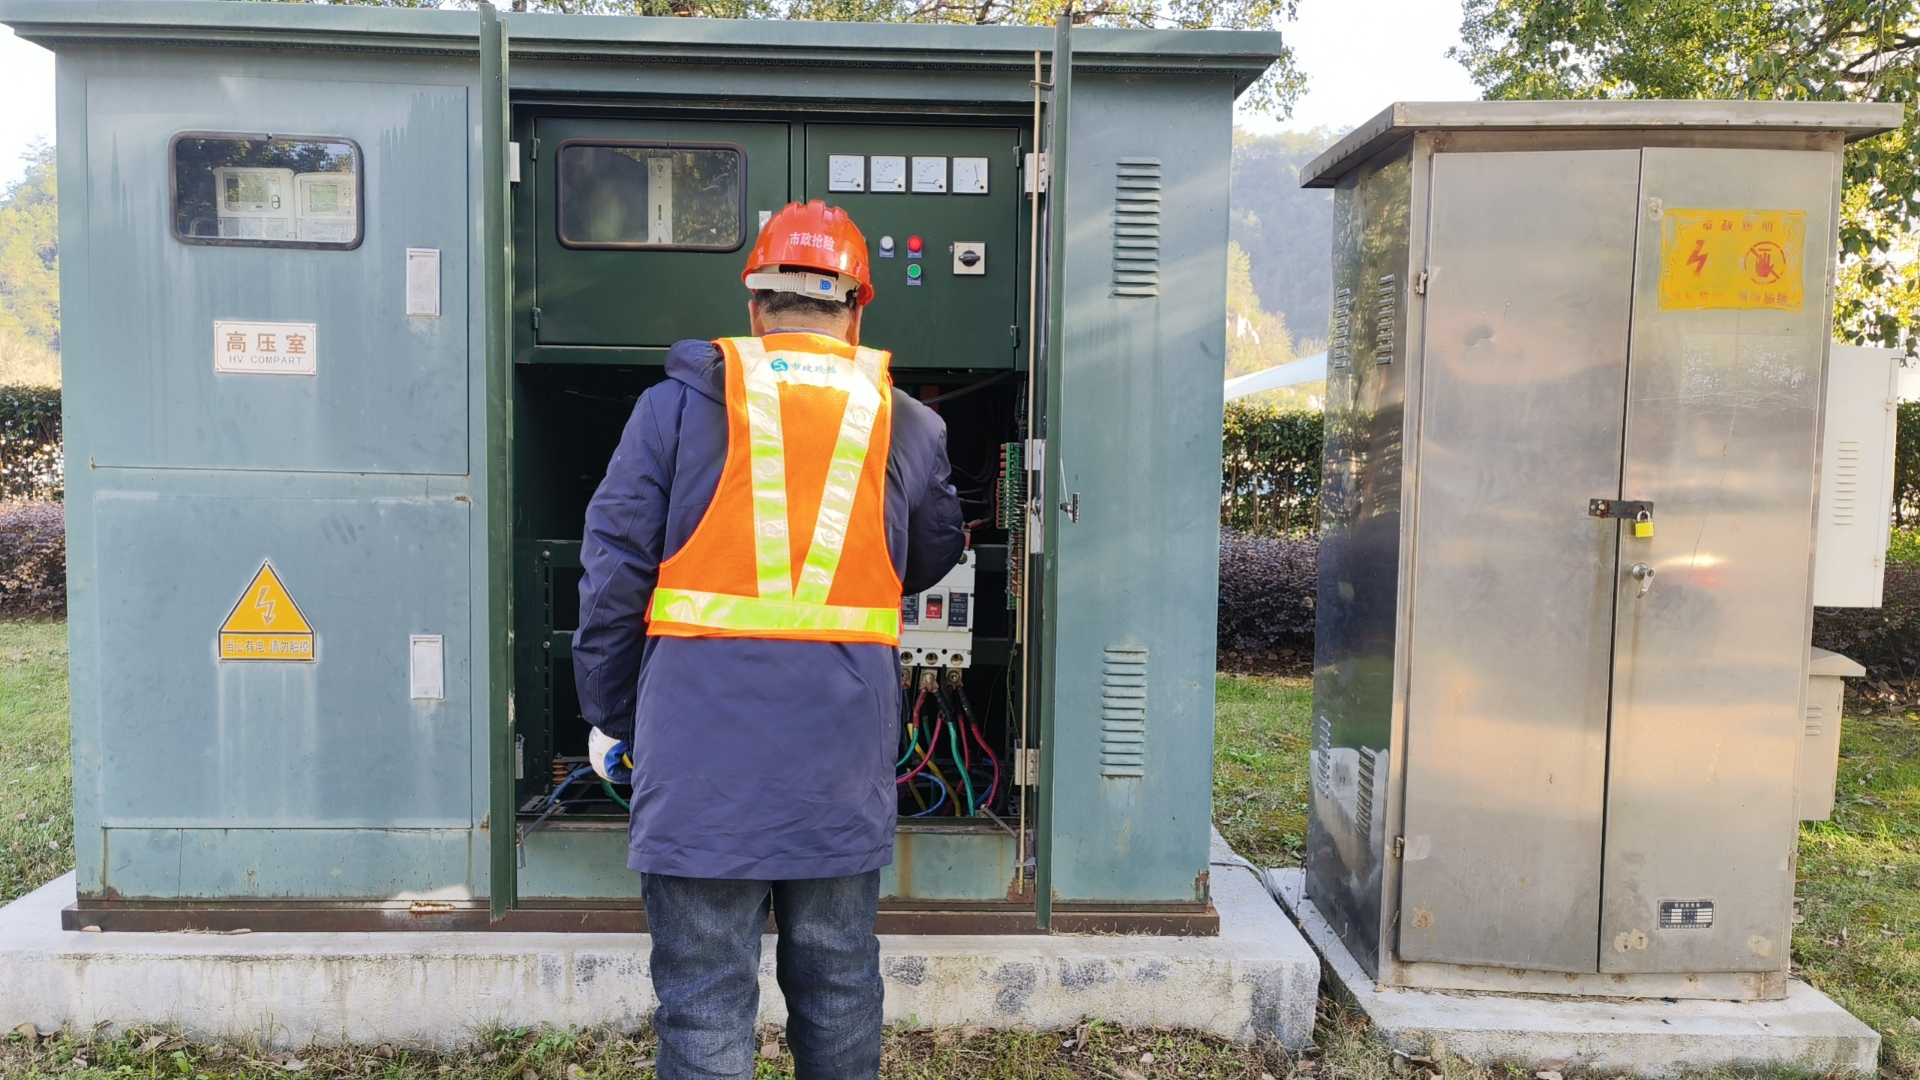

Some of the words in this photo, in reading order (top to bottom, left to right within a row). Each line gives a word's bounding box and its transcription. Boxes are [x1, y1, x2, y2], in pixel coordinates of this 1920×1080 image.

[789, 231, 835, 252] 市政抢险
[226, 330, 307, 354] 高压室
[229, 355, 244, 363] HV
[250, 355, 303, 365] COMPART
